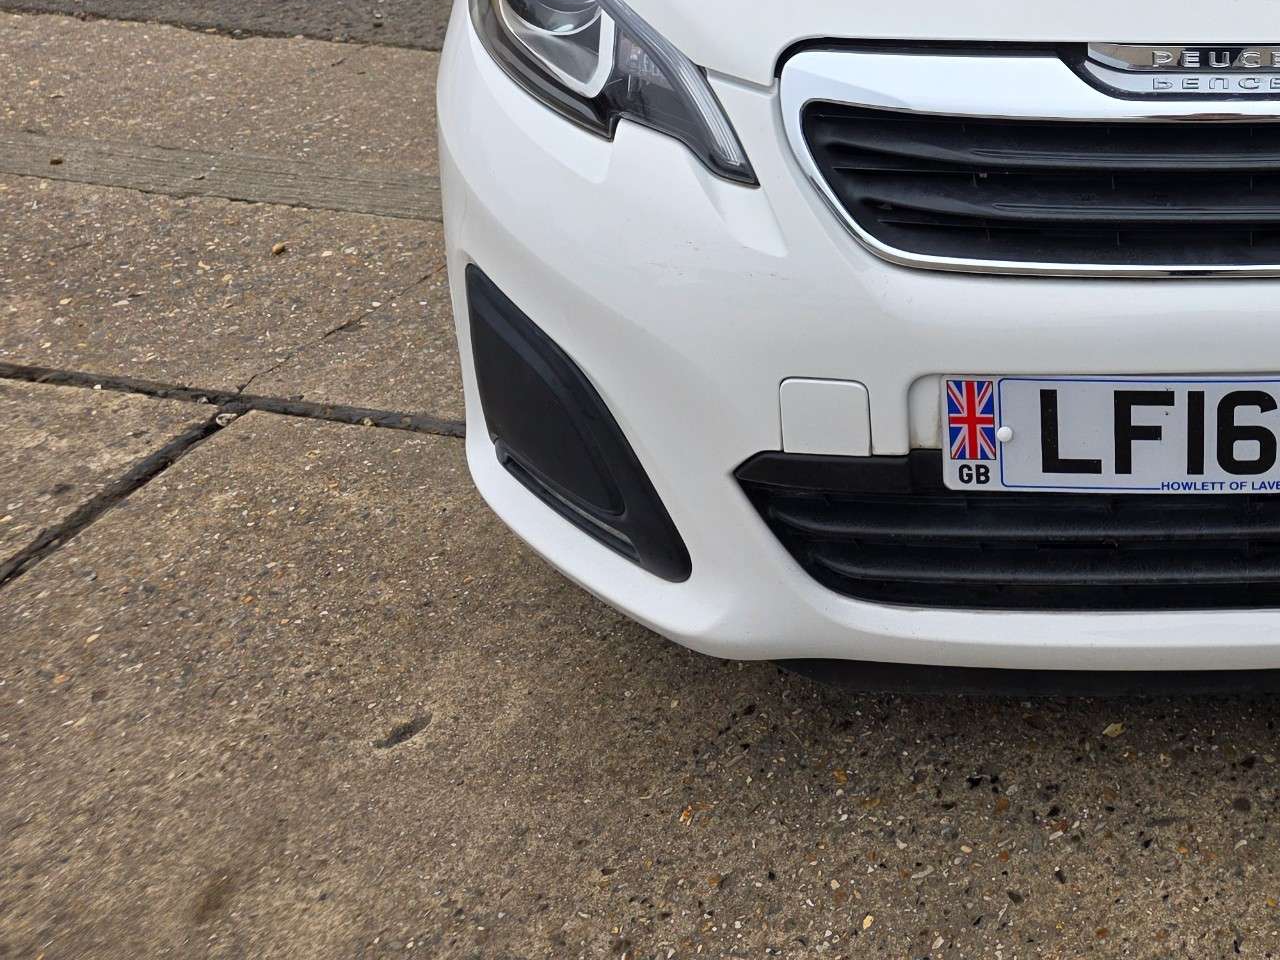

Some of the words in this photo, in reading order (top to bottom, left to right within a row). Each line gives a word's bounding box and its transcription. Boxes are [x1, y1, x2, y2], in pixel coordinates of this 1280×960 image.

[1039, 388, 1278, 476] LF16
[958, 463, 990, 485] GB
[1160, 481, 1226, 491] HOWLETT
[1229, 481, 1248, 491] OF
